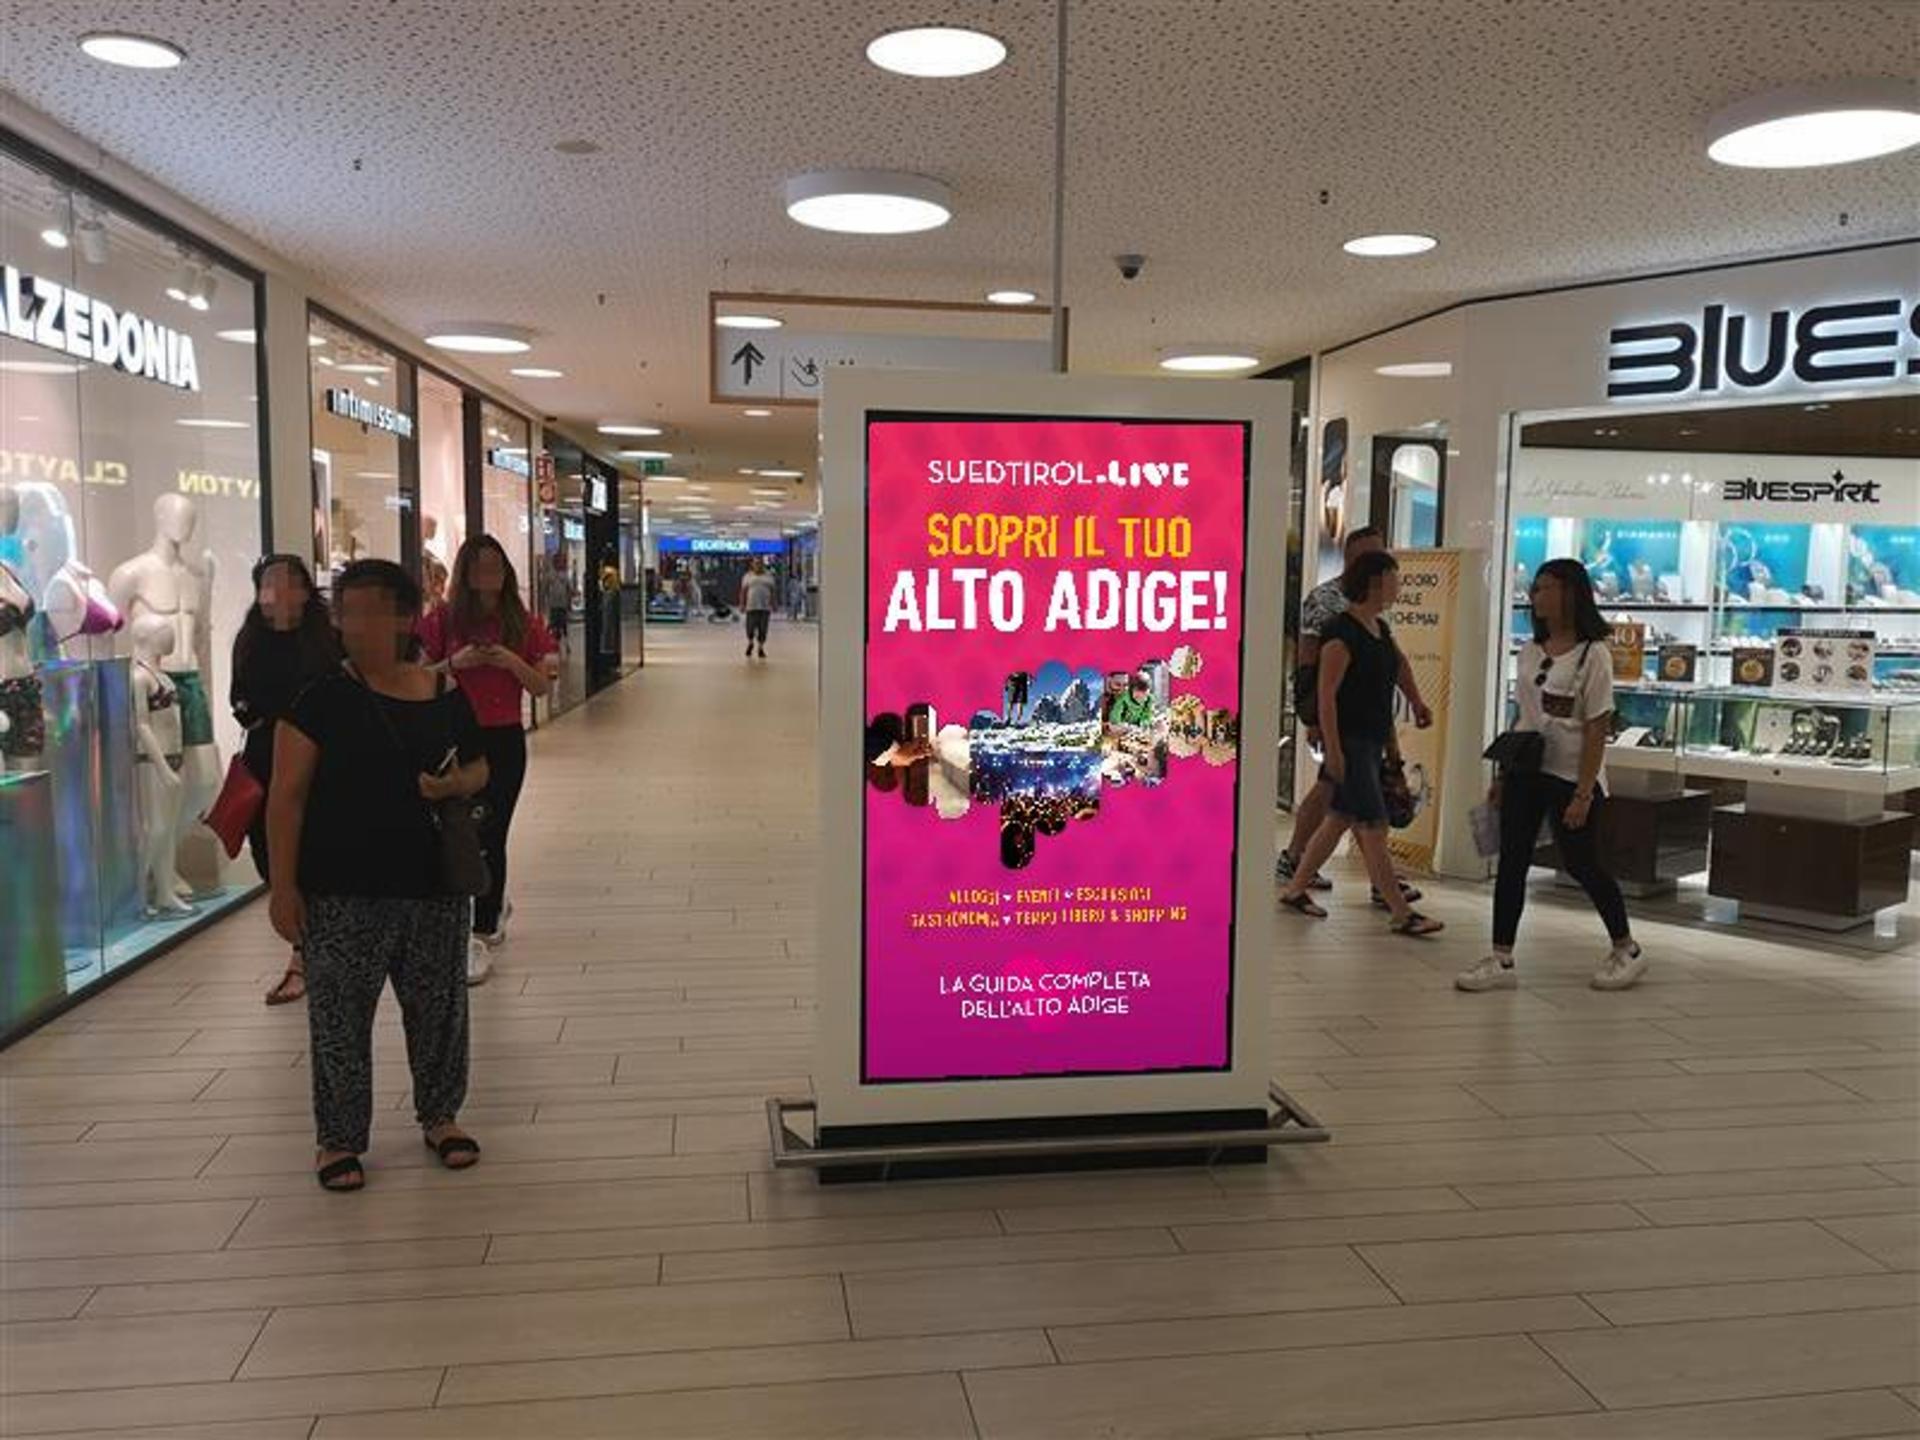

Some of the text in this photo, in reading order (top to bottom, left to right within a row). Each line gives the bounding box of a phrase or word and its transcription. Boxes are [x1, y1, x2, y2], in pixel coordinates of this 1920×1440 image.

[0, 265, 200, 392] LZEDONIA
[927, 512, 1193, 558] SCOPRI IL TUO
[883, 567, 1229, 633] ALTO ADIGE!
[940, 970, 1151, 994] LA GUIDA COMPLETA
[961, 995, 1130, 1019] DELL'ALTO ADIGE
